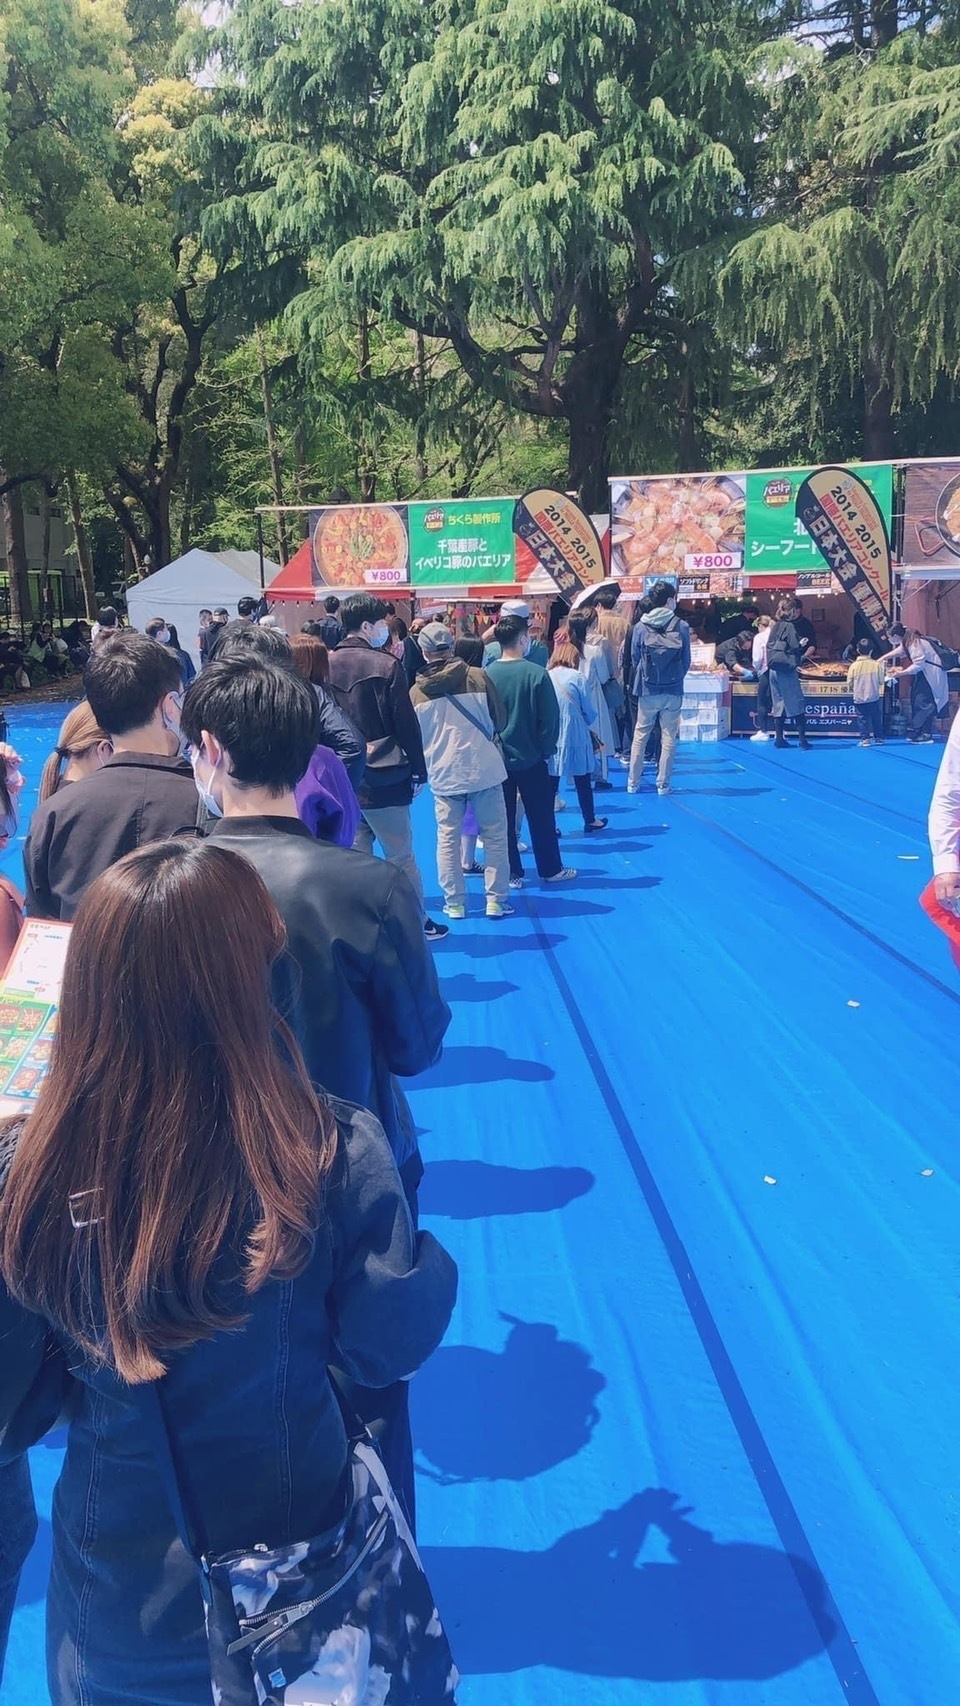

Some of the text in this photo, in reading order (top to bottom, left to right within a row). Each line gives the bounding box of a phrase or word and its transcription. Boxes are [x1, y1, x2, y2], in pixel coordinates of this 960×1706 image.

[831, 486, 857, 521] 2014
[855, 525, 881, 559] 2015
[544, 505, 571, 535] 2014
[571, 537, 597, 569] 2015
[437, 538, 487, 554] 千葉産豚と
[809, 515, 857, 581] 日本大会
[415, 554, 512, 570] イベリコ豚のパエリア
[525, 529, 576, 591] 日本大会
[693, 555, 732, 567] ¥800
[371, 571, 401, 581] ¥800
[805, 702, 856, 718] españa
